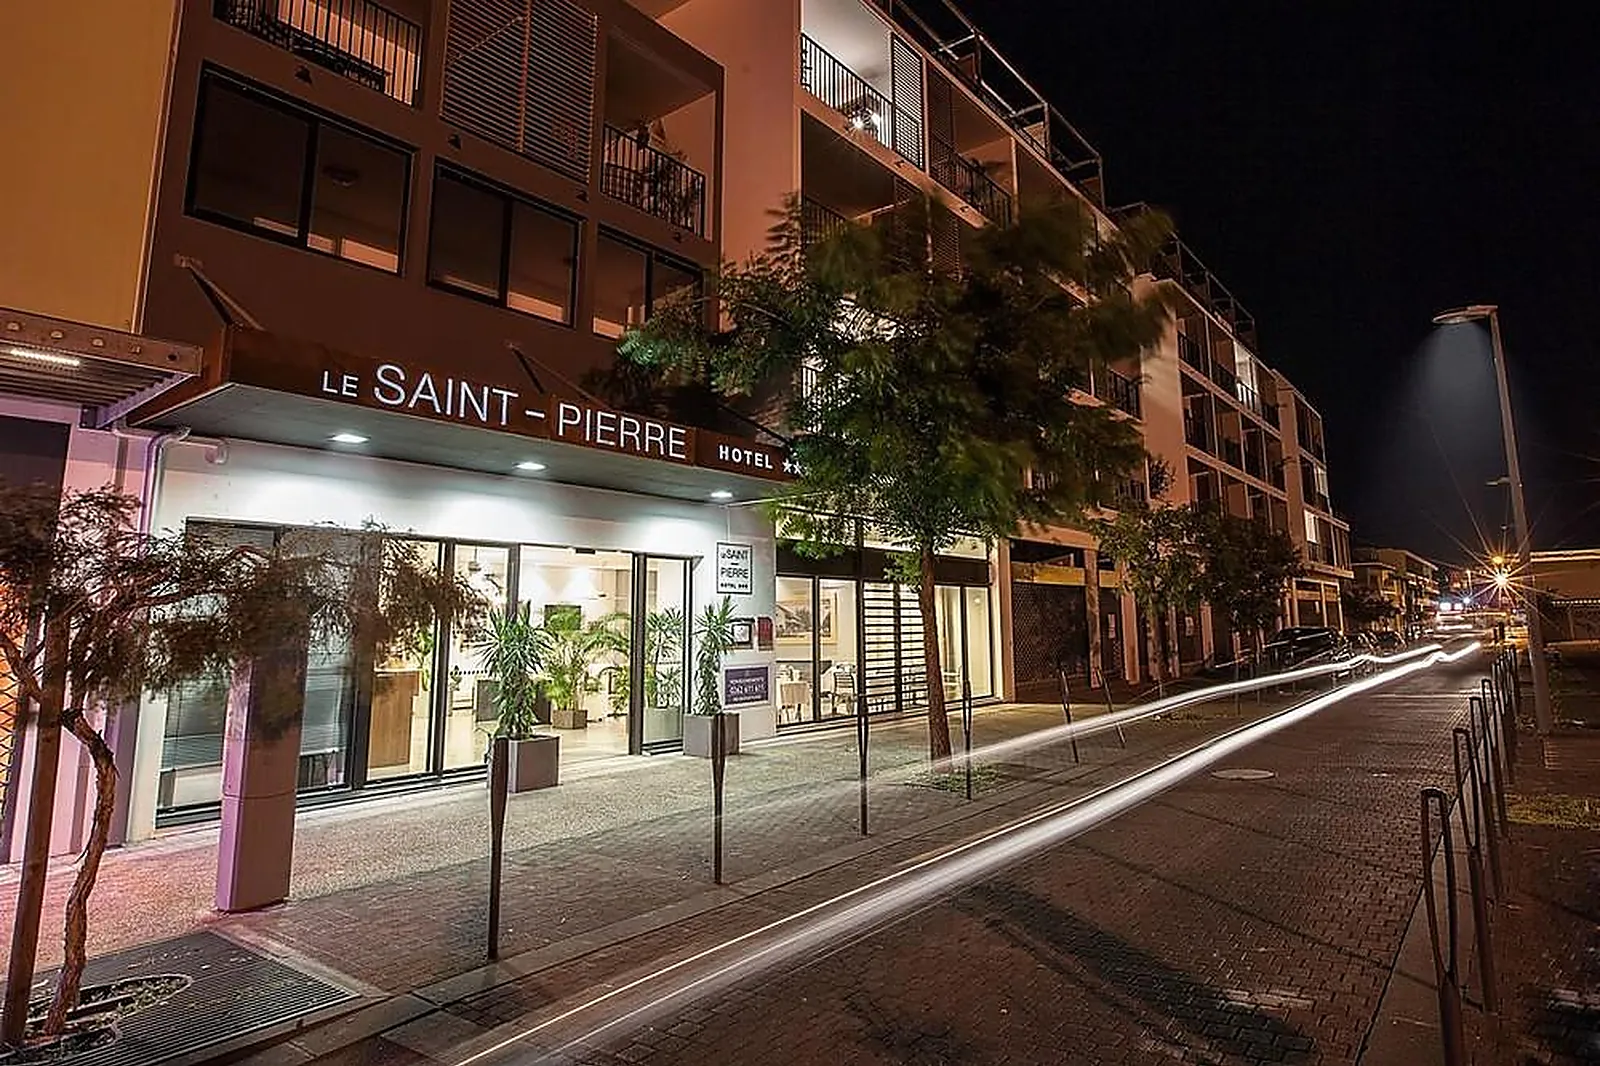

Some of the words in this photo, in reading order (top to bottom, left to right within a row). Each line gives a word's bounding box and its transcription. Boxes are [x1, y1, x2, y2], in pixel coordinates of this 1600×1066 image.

[322, 370, 359, 397] LE
[374, 363, 519, 426] SAINT
[557, 402, 686, 459] PIERRE
[718, 444, 774, 470] HOTEL
[726, 548, 749, 560] SAINT
[720, 567, 749, 579] PIERRE
